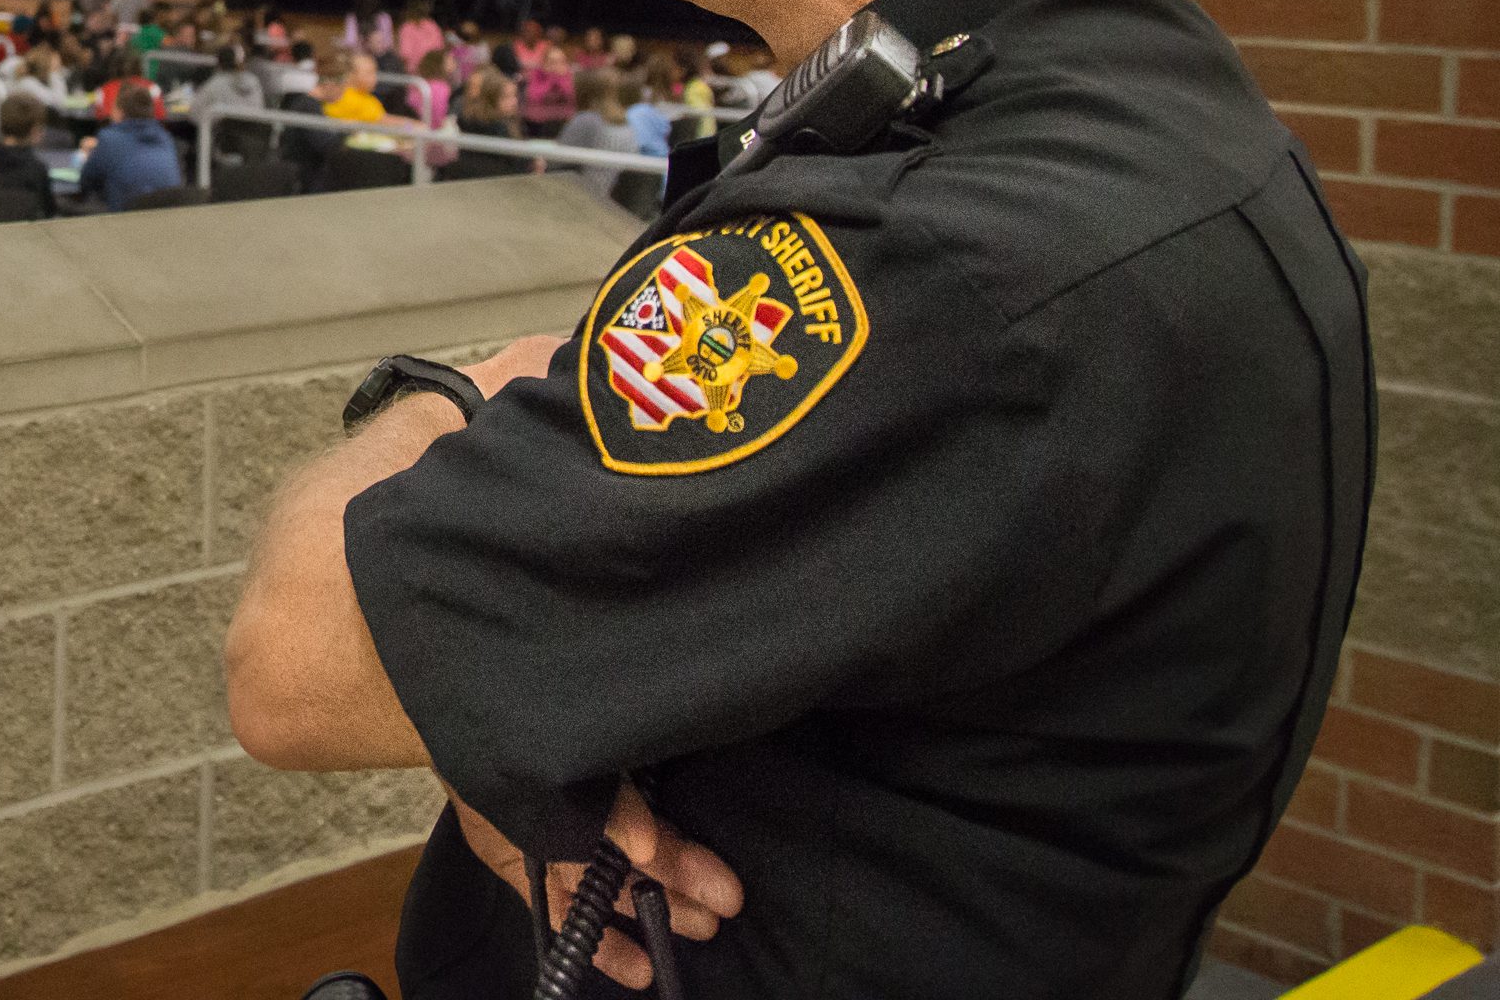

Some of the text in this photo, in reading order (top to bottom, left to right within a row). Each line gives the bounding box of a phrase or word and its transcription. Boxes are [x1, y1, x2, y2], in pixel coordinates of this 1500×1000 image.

[761, 221, 842, 344] SHERIFF
[702, 309, 751, 351] SHERIFF
[686, 354, 718, 382] OHIO
